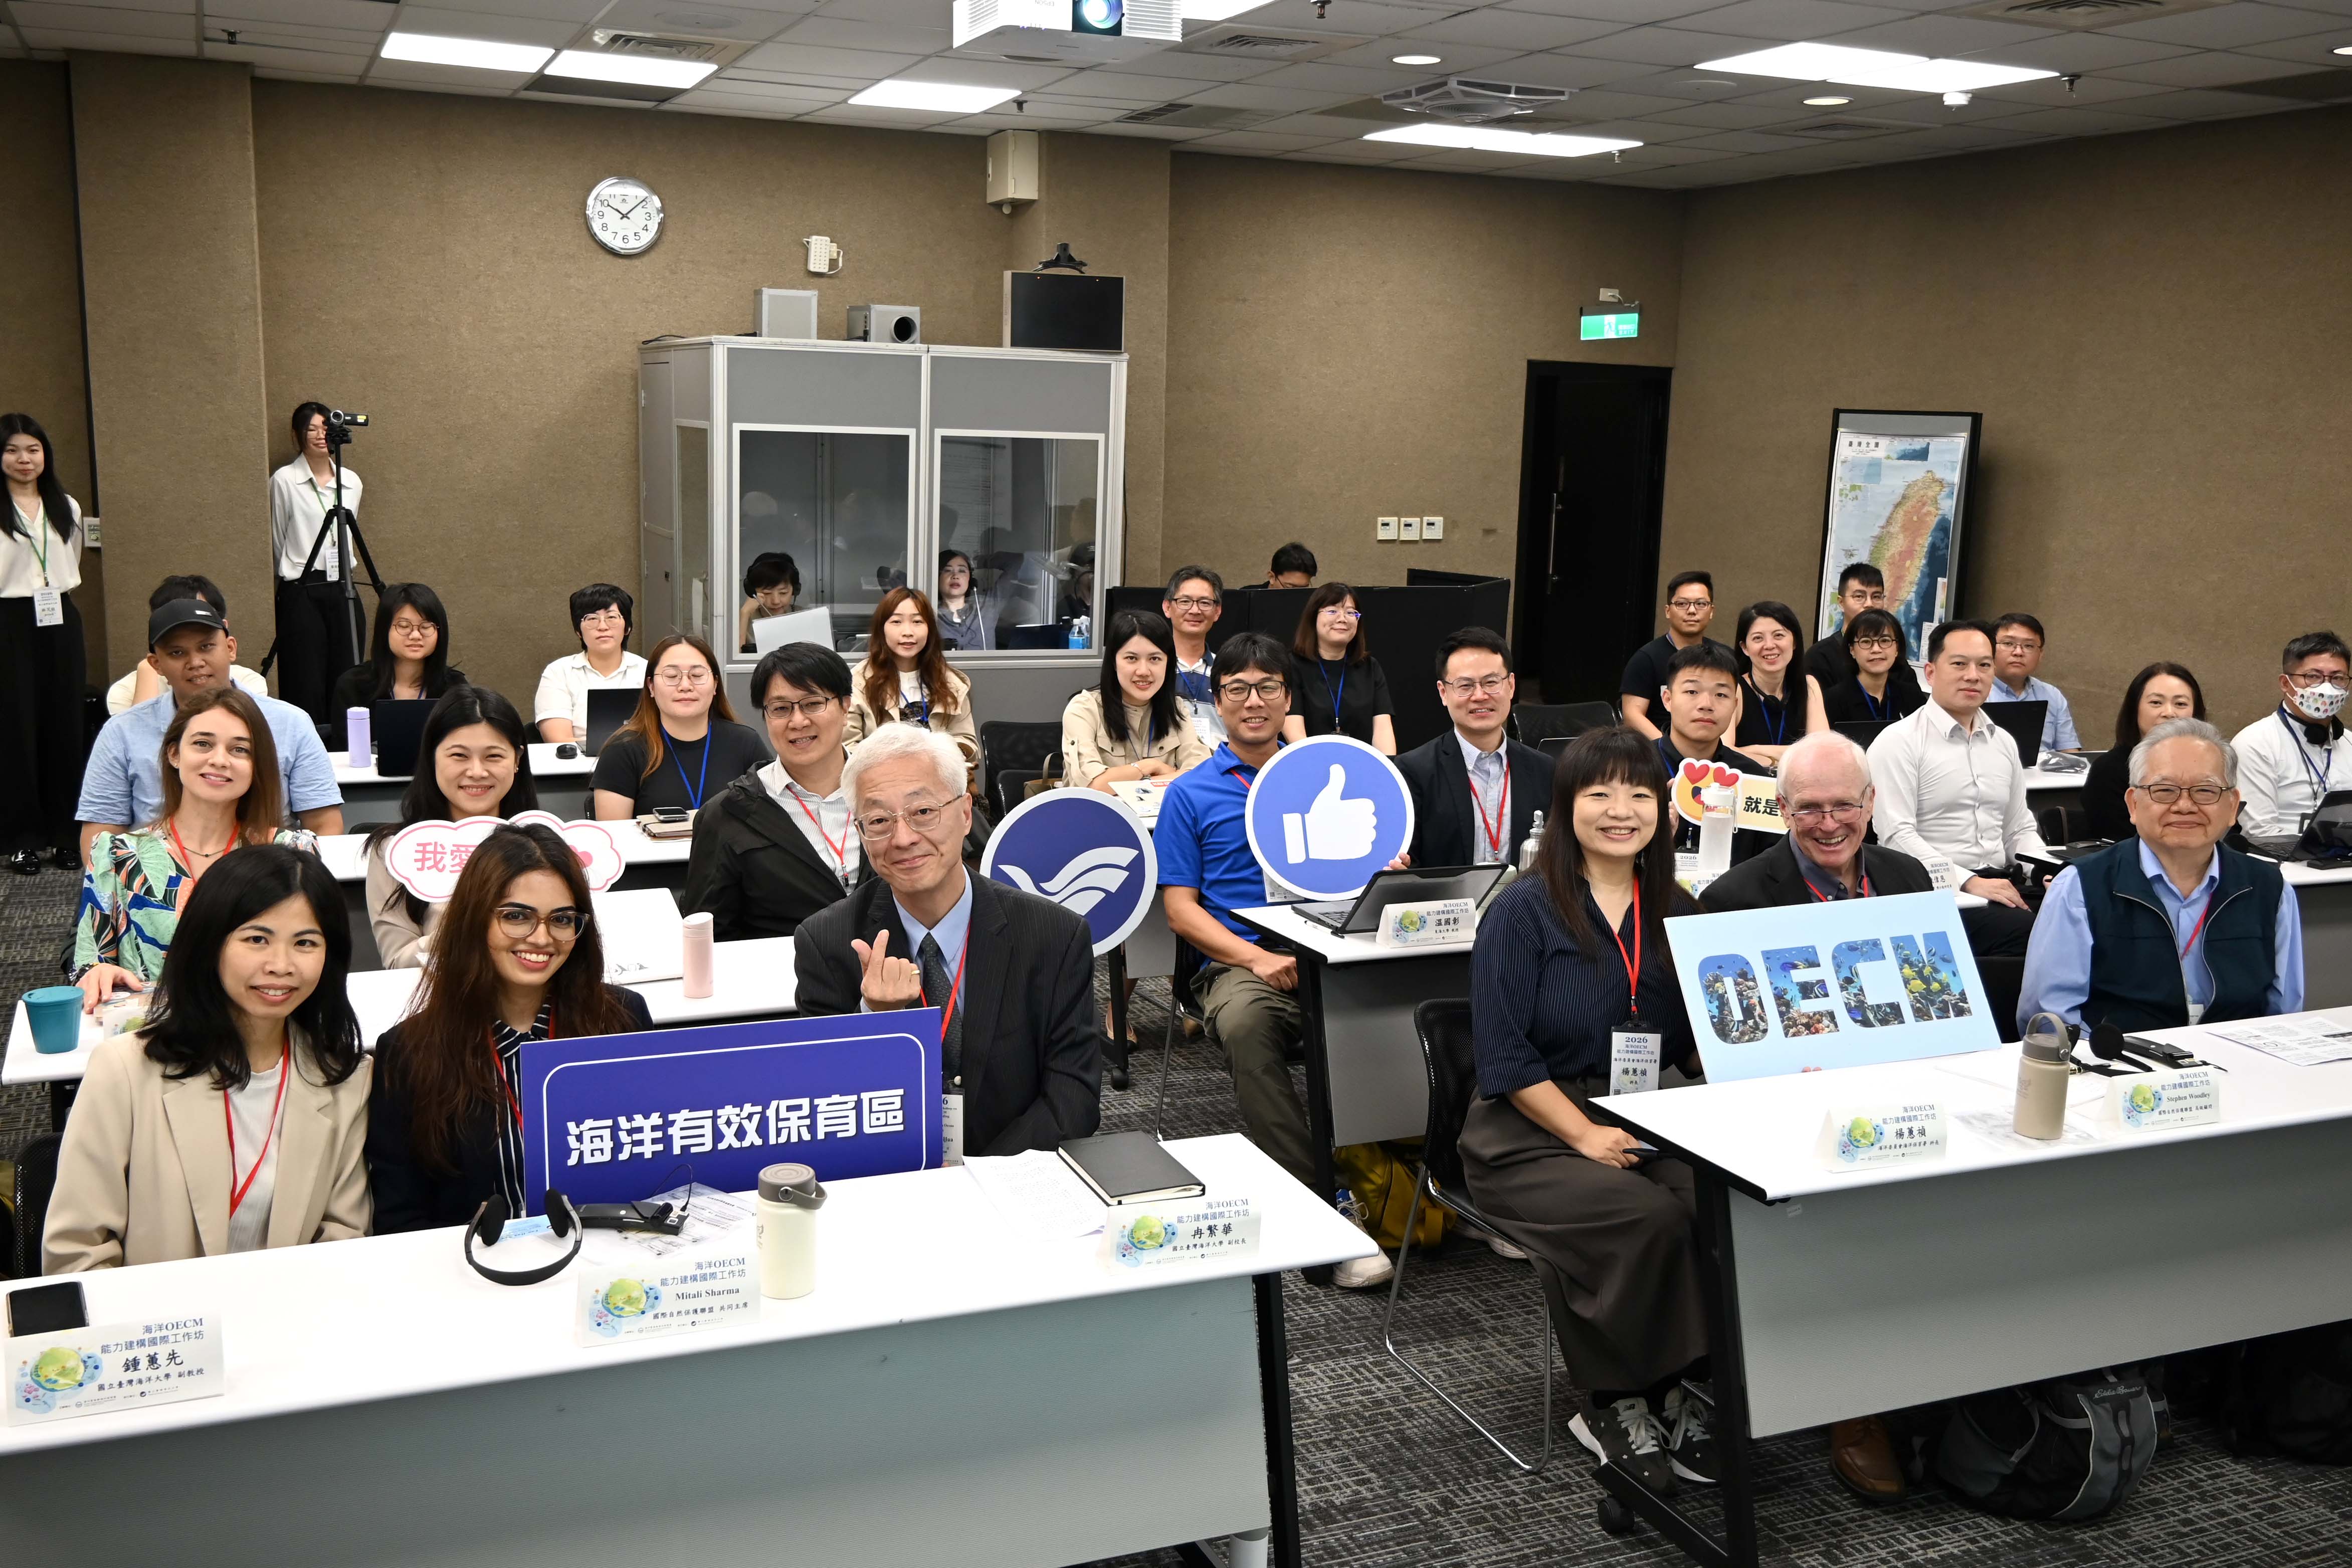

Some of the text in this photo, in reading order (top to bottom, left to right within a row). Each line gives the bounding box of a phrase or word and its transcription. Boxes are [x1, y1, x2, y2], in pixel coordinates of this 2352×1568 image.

[600, 199, 609, 208] 10
[642, 201, 648, 209] 2
[598, 211, 604, 219] 9
[645, 212, 652, 221] 3
[602, 223, 608, 231] 8
[642, 224, 649, 232] 4
[612, 232, 618, 240] 7
[622, 235, 629, 244] 6
[634, 232, 641, 241] 5
[1743, 796, 1780, 816] 就是
[1698, 931, 1973, 1044] OECM
[2167, 1092, 2211, 1103] Stephen Woodley
[1902, 1104, 1934, 1113] 海洋OECM
[1882, 1113, 1936, 1125] 能力建構國際工作坊
[566, 1088, 904, 1166] 海洋有效保育區
[1206, 1199, 1248, 1210] 海洋OECM
[1177, 1209, 1249, 1224] 能力建構國際工作坊
[1191, 1222, 1233, 1240] 冉繁華
[1172, 1241, 1224, 1252] 國立臺灣海洋大學
[695, 1258, 745, 1271] 海洋OECM
[660, 1269, 746, 1287] 能力建構國際工作坊
[675, 1287, 740, 1301] Mitali Sharma
[653, 1301, 748, 1320] 國際自然保護聯盟 共同主席
[142, 1318, 204, 1335] 海洋OECM
[101, 1330, 205, 1354] 能力建構國際工作坊
[122, 1349, 184, 1373] 鍾蕙先
[98, 1367, 205, 1392] 國立臺灣海洋大學 副教授
[2093, 1386, 2141, 1399] Eddie Bauer
